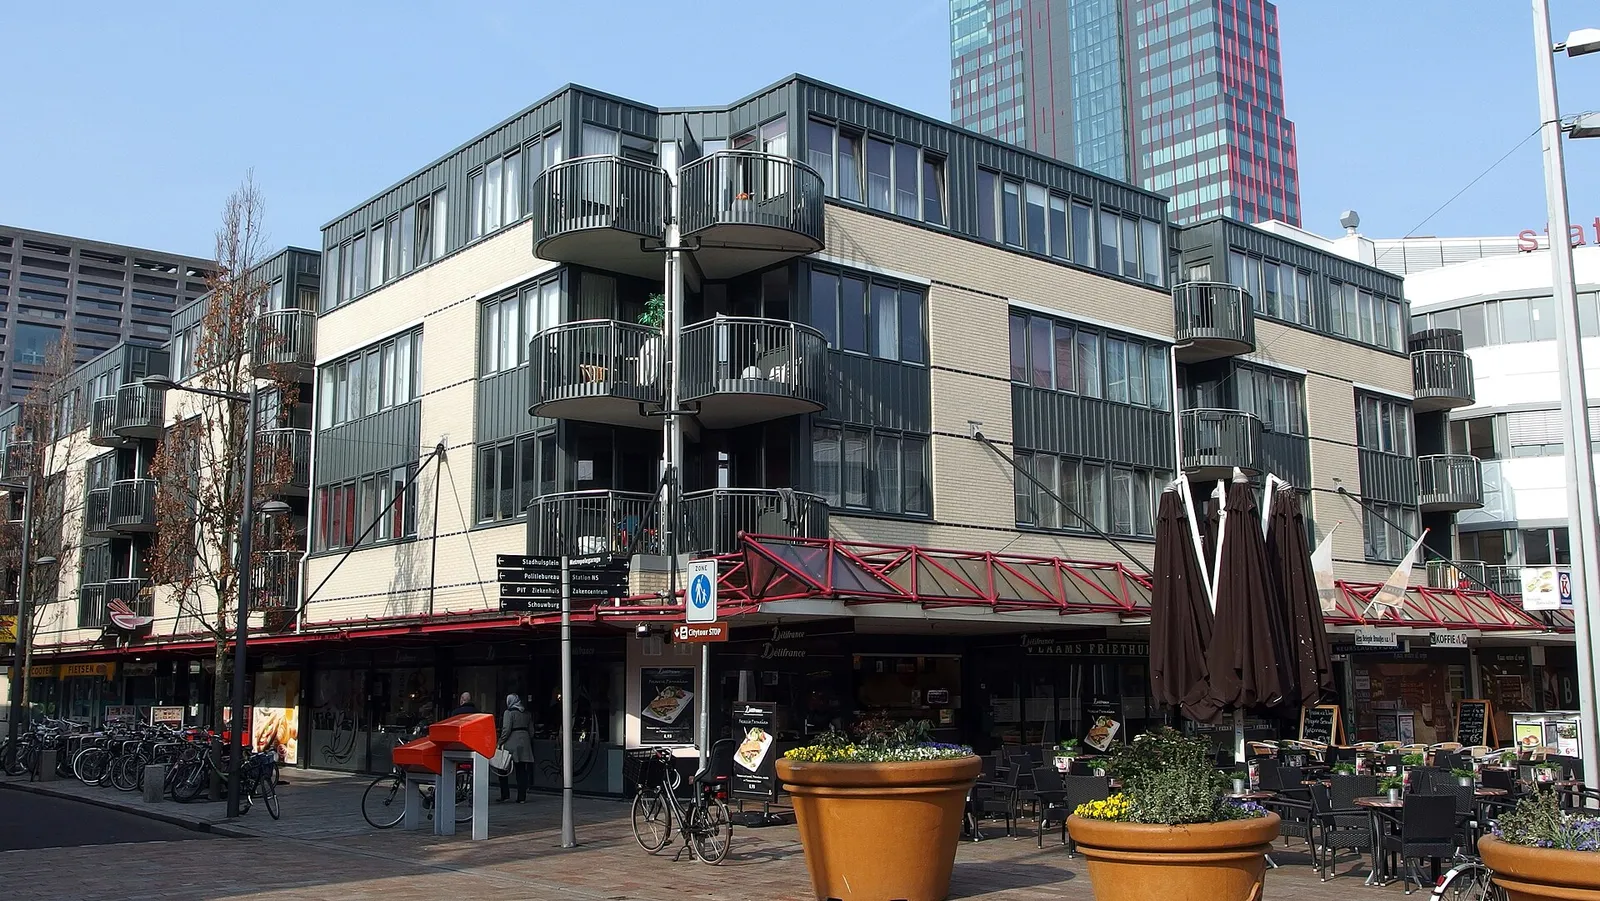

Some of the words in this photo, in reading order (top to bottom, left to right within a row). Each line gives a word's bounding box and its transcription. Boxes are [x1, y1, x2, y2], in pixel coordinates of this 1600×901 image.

[522, 558, 559, 567] Stadhuisplein
[524, 572, 560, 580] Politiebureau
[531, 586, 560, 594] Ziekenhuis
[572, 587, 608, 595] Zakencentrum
[527, 601, 560, 609] Schouwburg
[688, 628, 708, 638] Citytour
[708, 628, 721, 636] STOP
[1436, 634, 1456, 644] KOFFIE
[1088, 643, 1149, 655] FRIETHUI
[68, 664, 94, 674] FIETSEN
